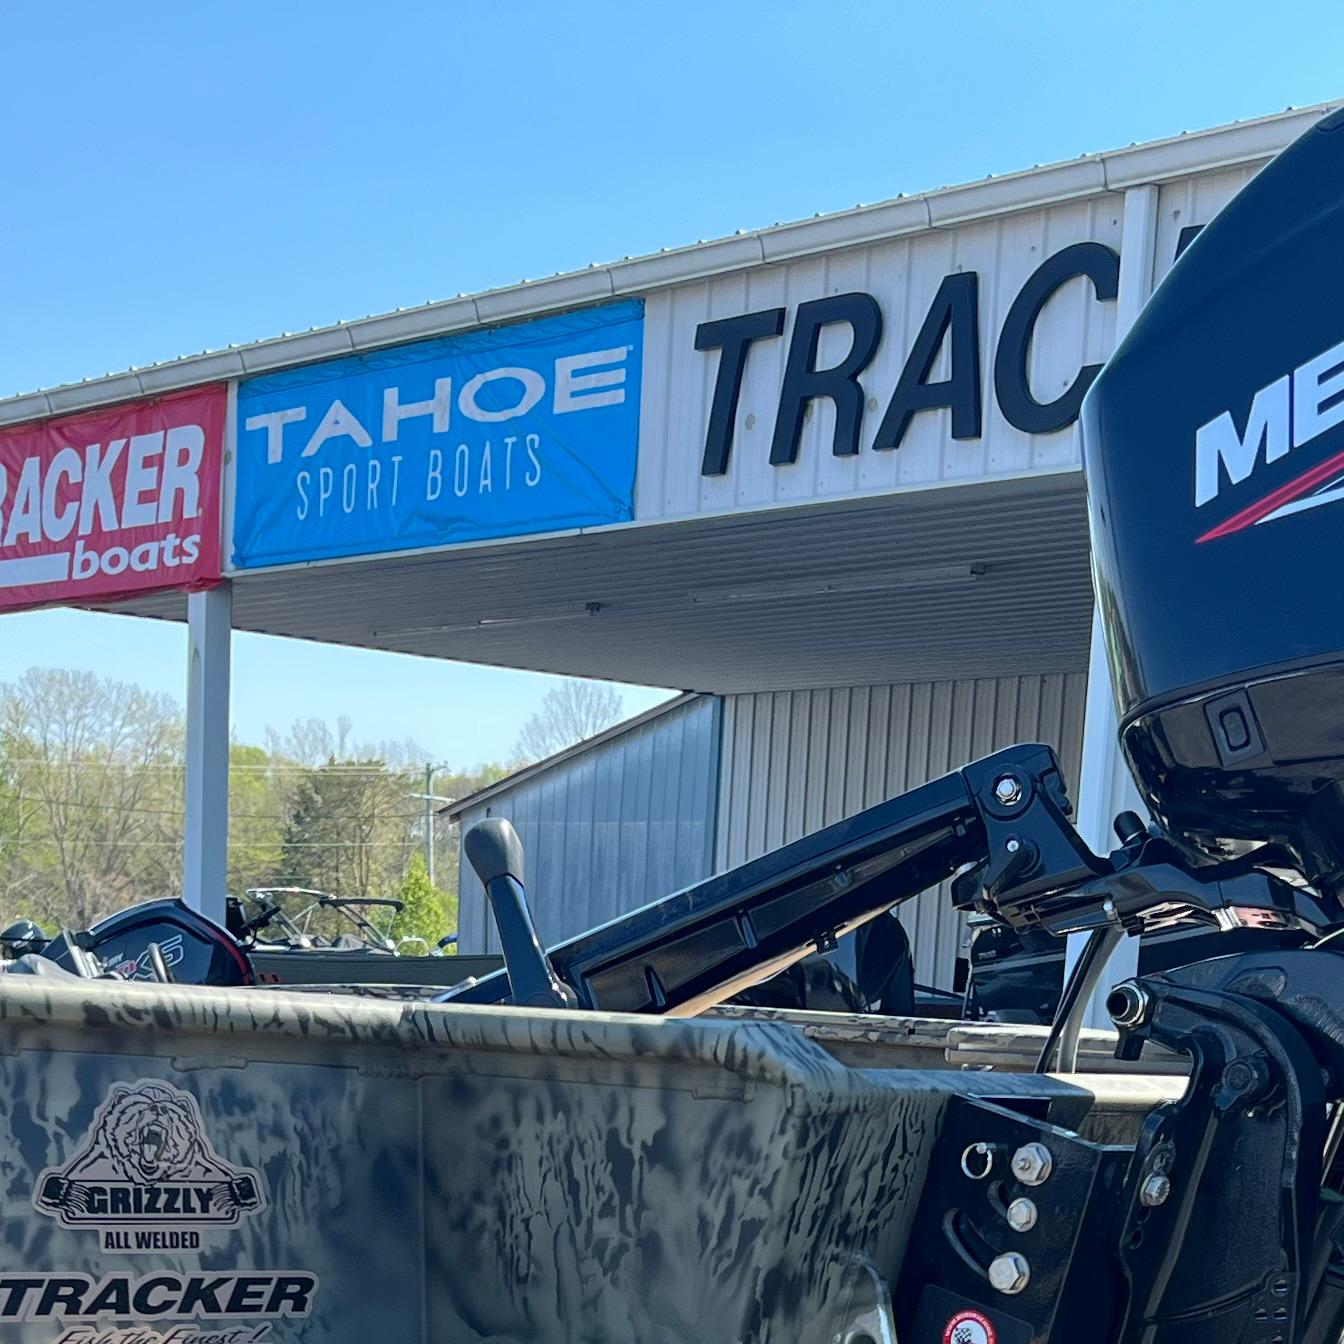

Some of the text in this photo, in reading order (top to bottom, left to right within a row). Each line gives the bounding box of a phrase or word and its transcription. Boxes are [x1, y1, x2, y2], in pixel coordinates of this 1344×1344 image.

[694, 226, 1206, 476] TRAC
[246, 346, 628, 465] TAHOE
[296, 433, 541, 521] SPORT BOATS
[72, 532, 200, 581] boats
[86, 1186, 215, 1214] GRIZZLY
[105, 1231, 200, 1249] ALL WELDED
